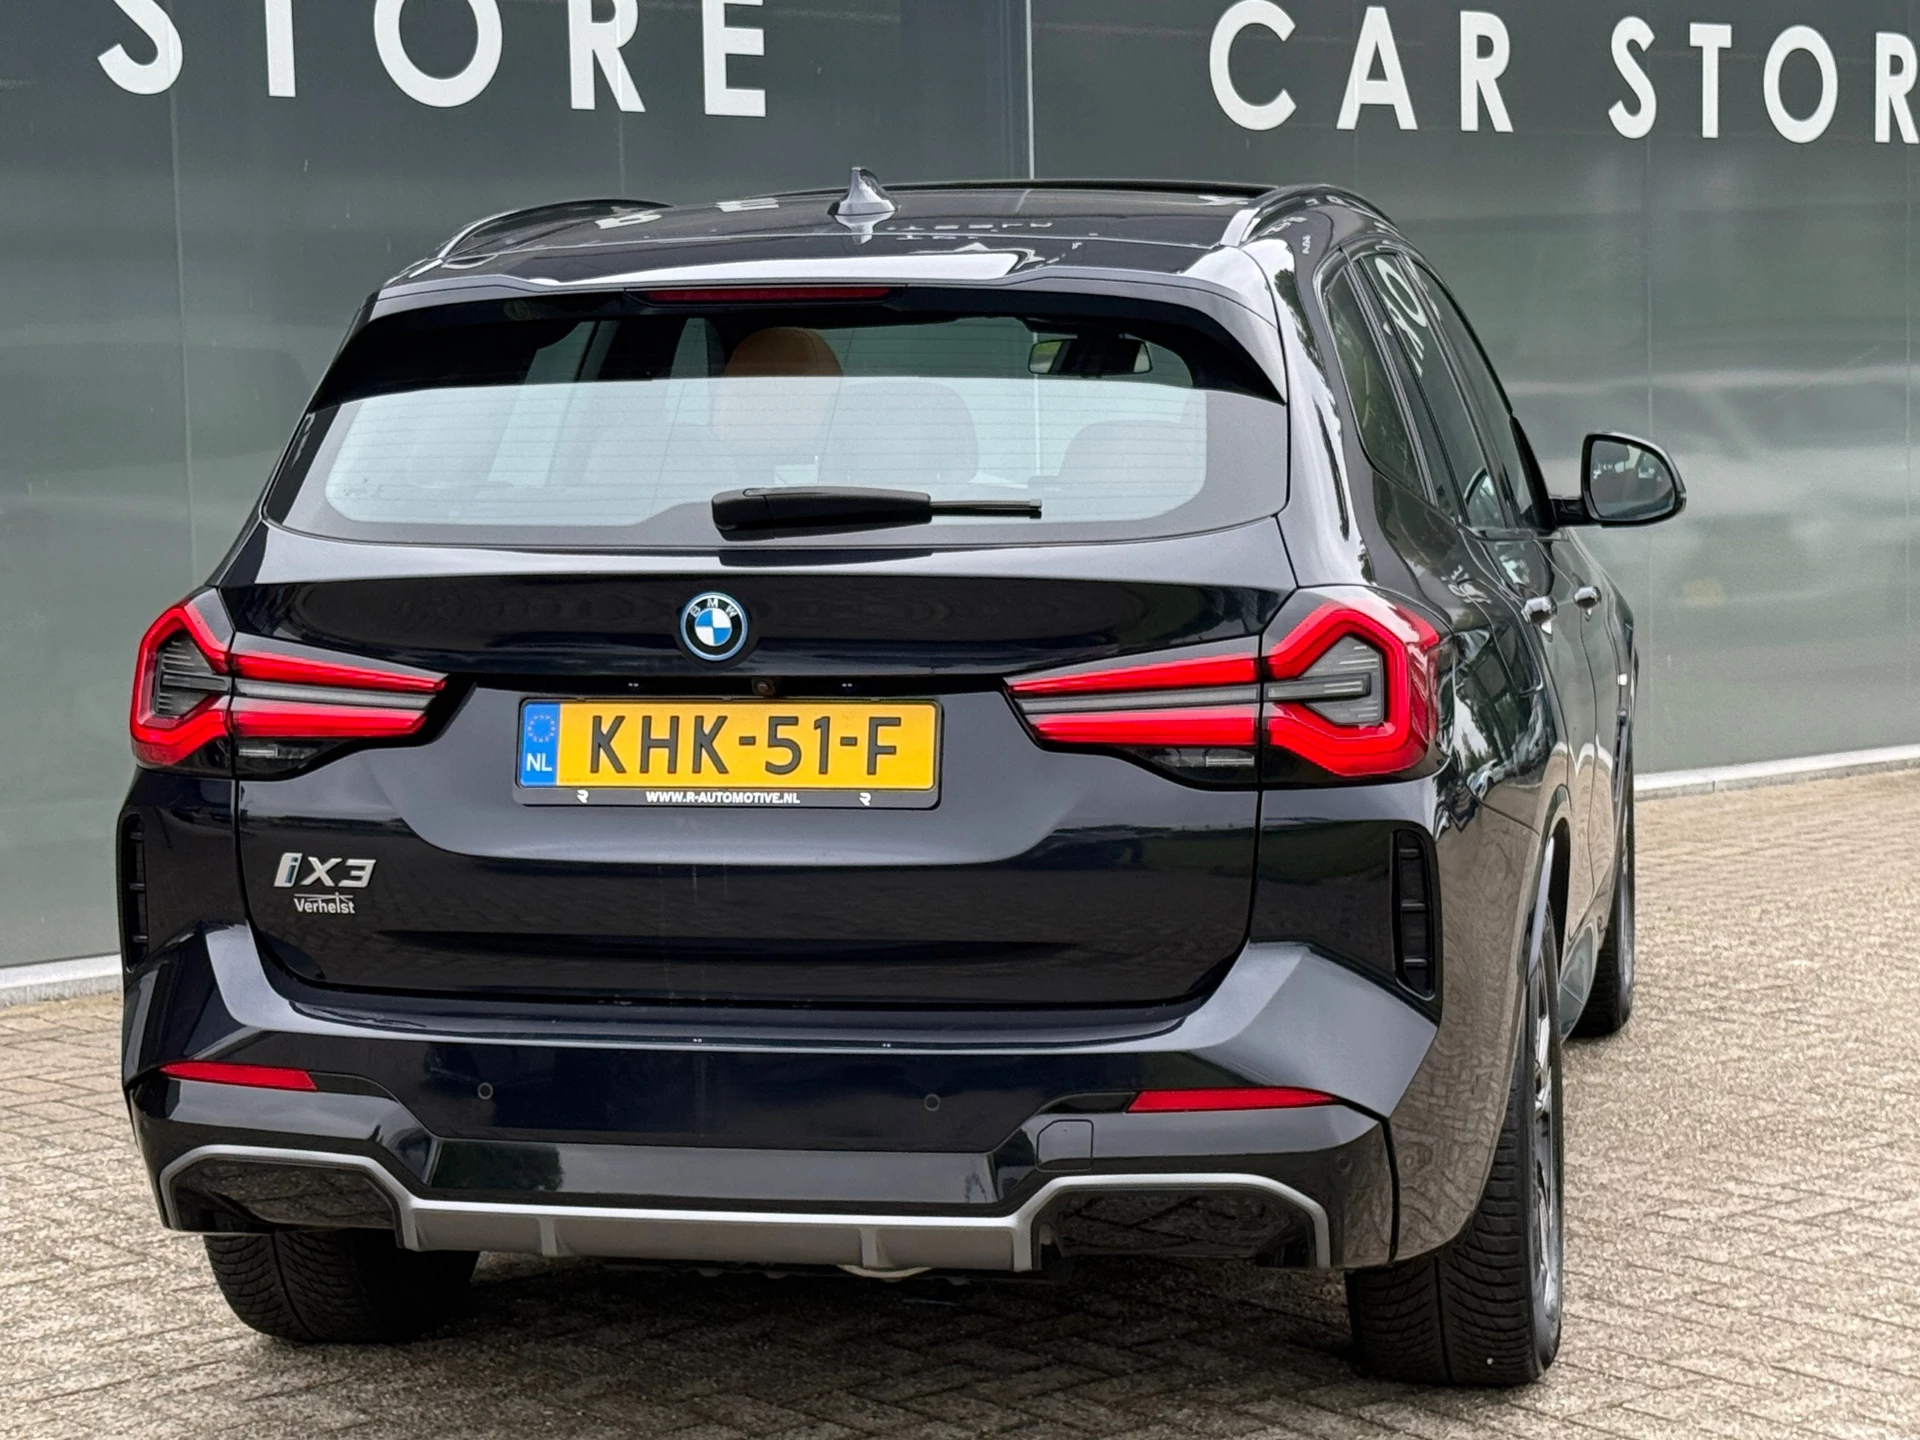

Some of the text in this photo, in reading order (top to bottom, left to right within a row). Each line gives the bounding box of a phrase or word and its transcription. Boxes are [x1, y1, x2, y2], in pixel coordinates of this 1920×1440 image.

[1209, 0, 1919, 144] CAR STOR
[689, 598, 738, 618] BMW
[589, 715, 902, 775] KHK-51-F
[526, 752, 552, 771] NL
[645, 791, 801, 804] WWW.R-AUTOMOTIVE.NL
[274, 852, 377, 888] iX3
[293, 894, 355, 914] Verhelst
